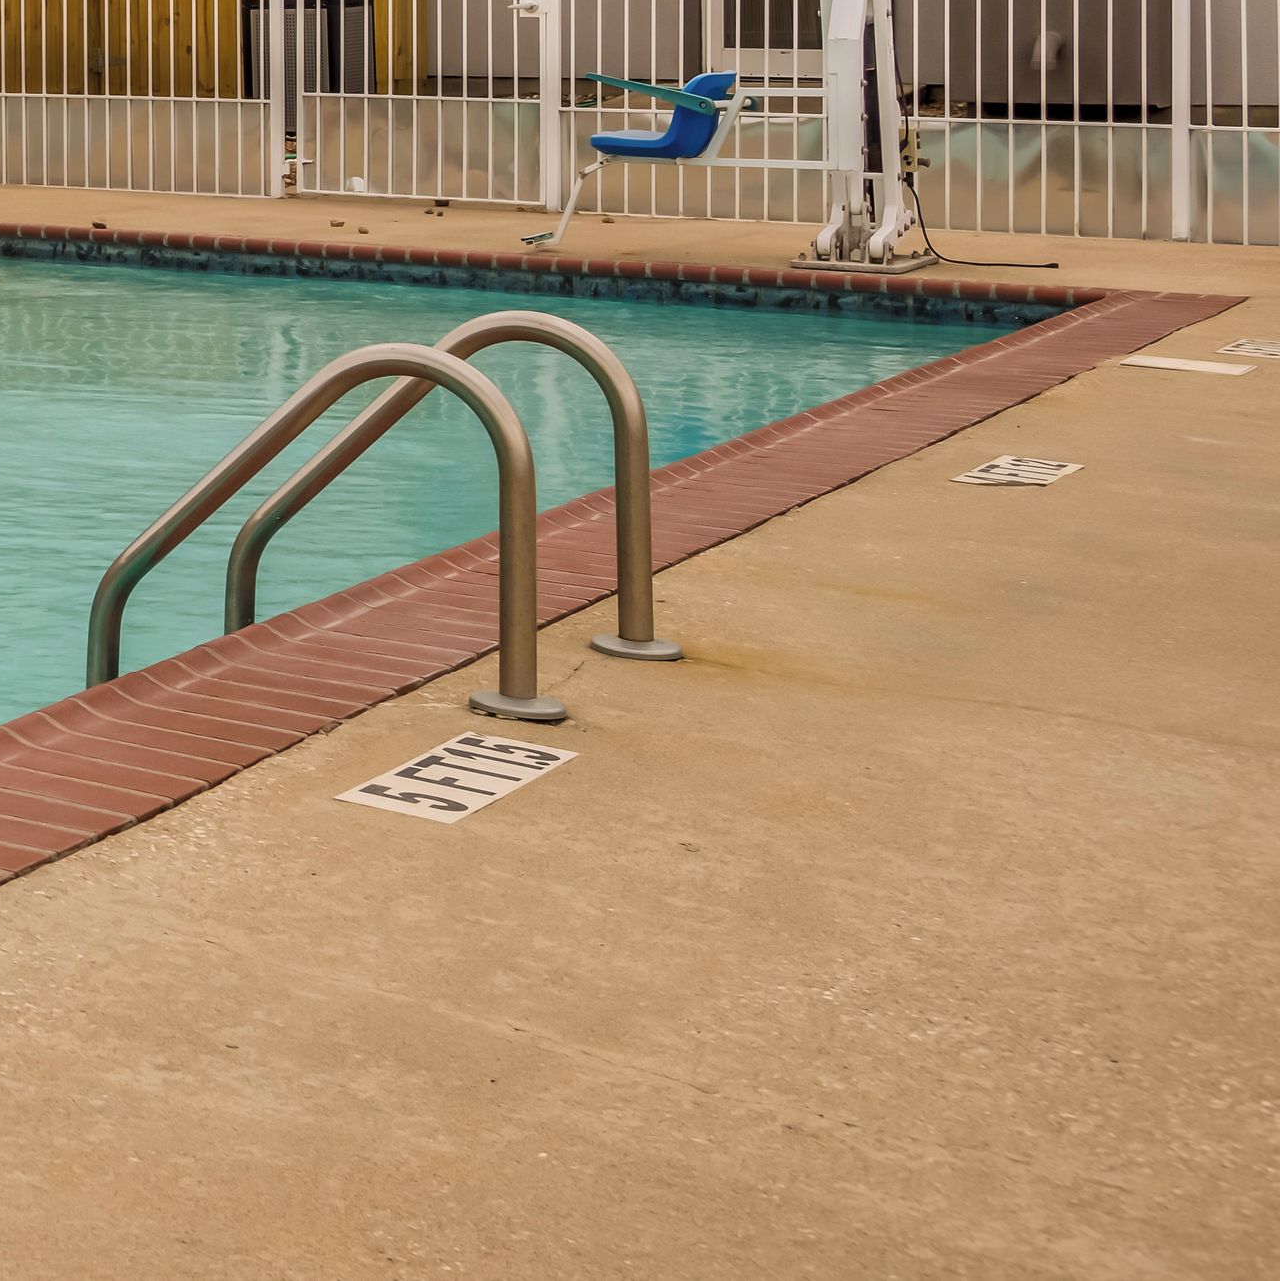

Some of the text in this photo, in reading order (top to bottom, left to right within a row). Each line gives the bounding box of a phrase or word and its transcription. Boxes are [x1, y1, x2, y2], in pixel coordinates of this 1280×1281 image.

[978, 464, 1058, 482] FT
[358, 736, 561, 812] 5 FT 1.5
